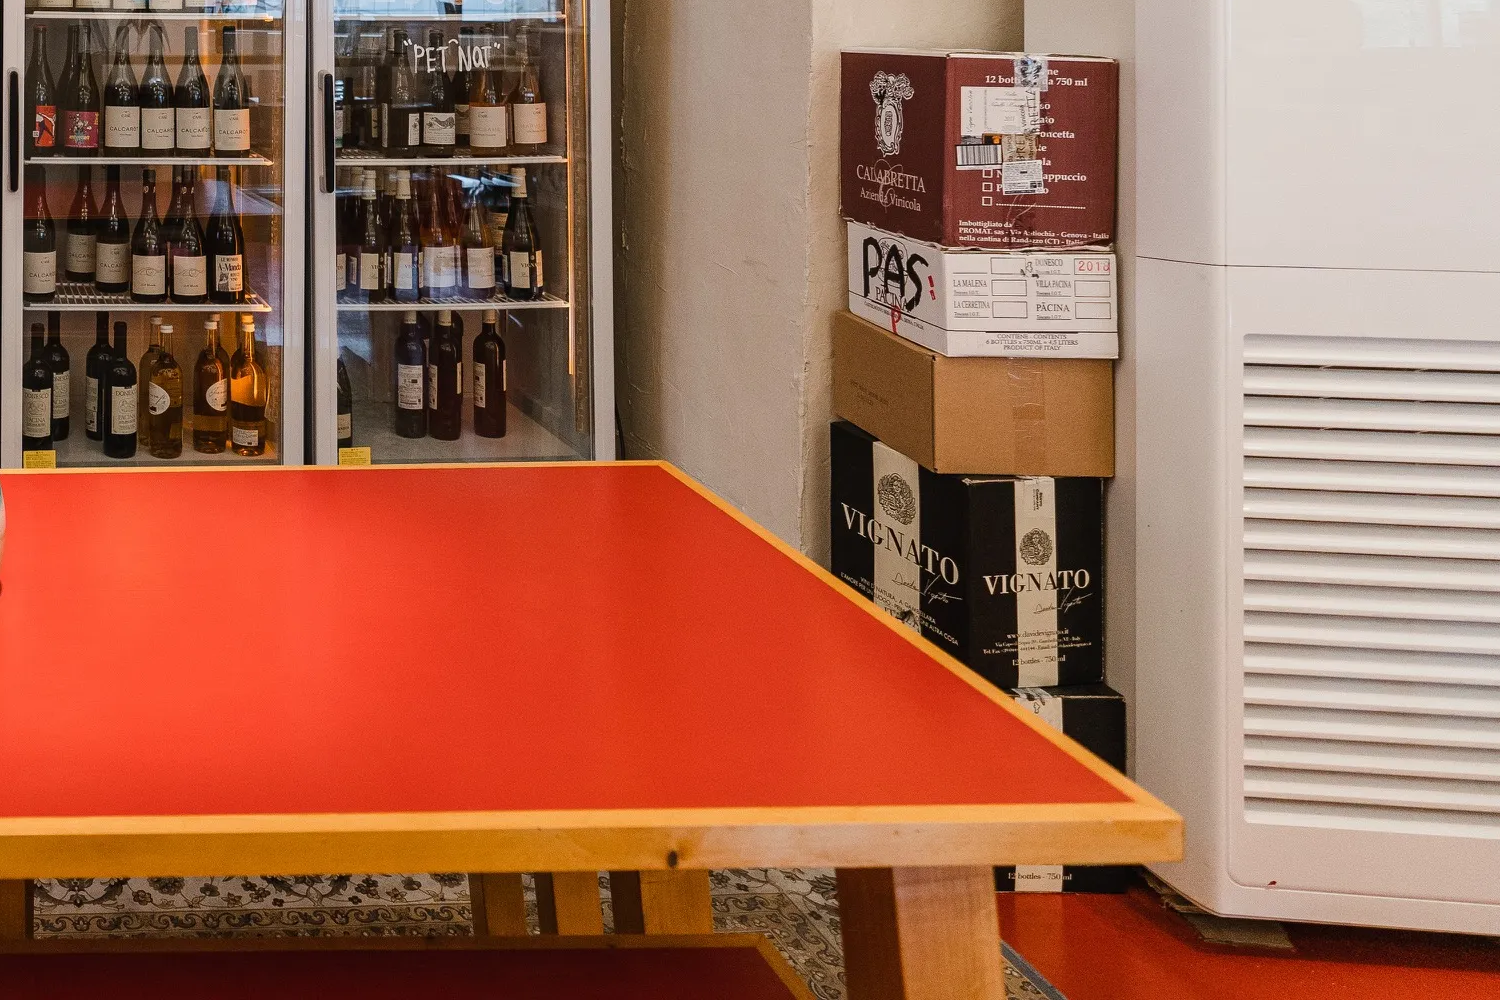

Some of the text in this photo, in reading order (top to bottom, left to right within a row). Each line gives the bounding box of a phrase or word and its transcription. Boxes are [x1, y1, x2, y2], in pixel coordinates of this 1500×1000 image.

[985, 75, 997, 84] 12
[1055, 77, 1088, 87] 750 ml
[856, 164, 926, 193] CALABRETTA
[860, 187, 921, 212] Azienda Vinicola
[959, 219, 1003, 229] Imbottigliato
[953, 279, 988, 288] LA MALENA
[1036, 280, 1050, 288] VILLA
[953, 301, 991, 309] LA CERRETINA
[841, 501, 960, 586] VIGNATO
[982, 568, 1090, 596] VIGNATO
[1017, 872, 1041, 880] bottles
